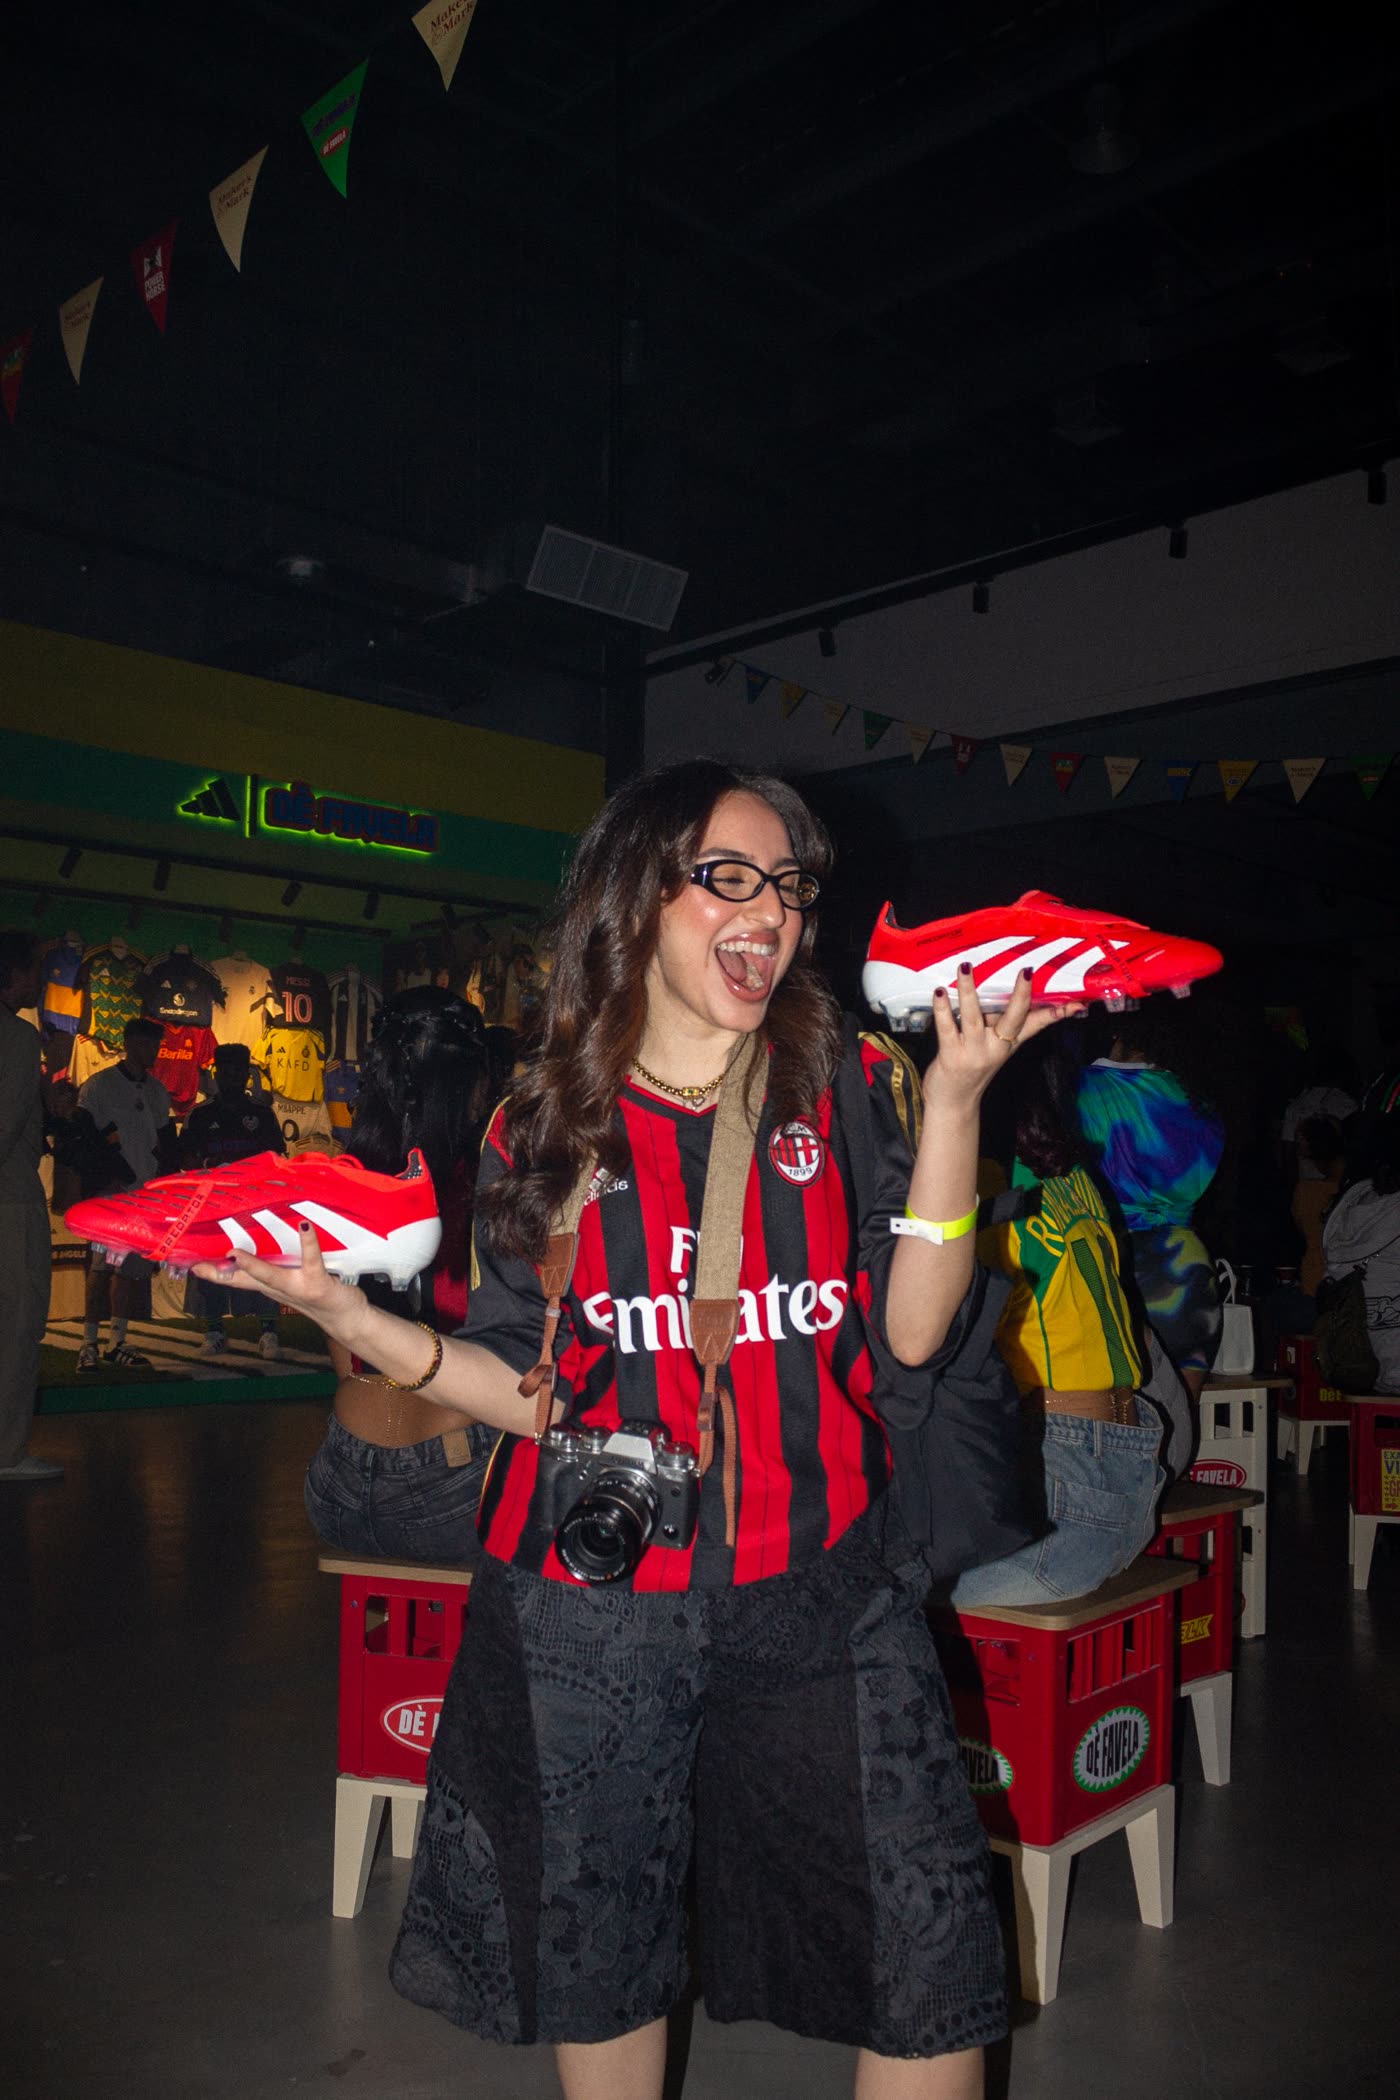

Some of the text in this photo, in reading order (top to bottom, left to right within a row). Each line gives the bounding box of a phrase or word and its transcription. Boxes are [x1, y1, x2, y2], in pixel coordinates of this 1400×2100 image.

[321, 799, 436, 846] FAVELA
[282, 991, 313, 1024] 10
[158, 1047, 194, 1061] Barilla
[789, 1167, 813, 1177] 1899
[160, 1194, 205, 1253] PREDATOR
[582, 1273, 848, 1355] Emiates
[1196, 1468, 1238, 1486] FAVELA
[398, 1704, 427, 1737] DÈ
[962, 1745, 1001, 1786] VELA
[1086, 1719, 1140, 1778] DÈ FAVELA
